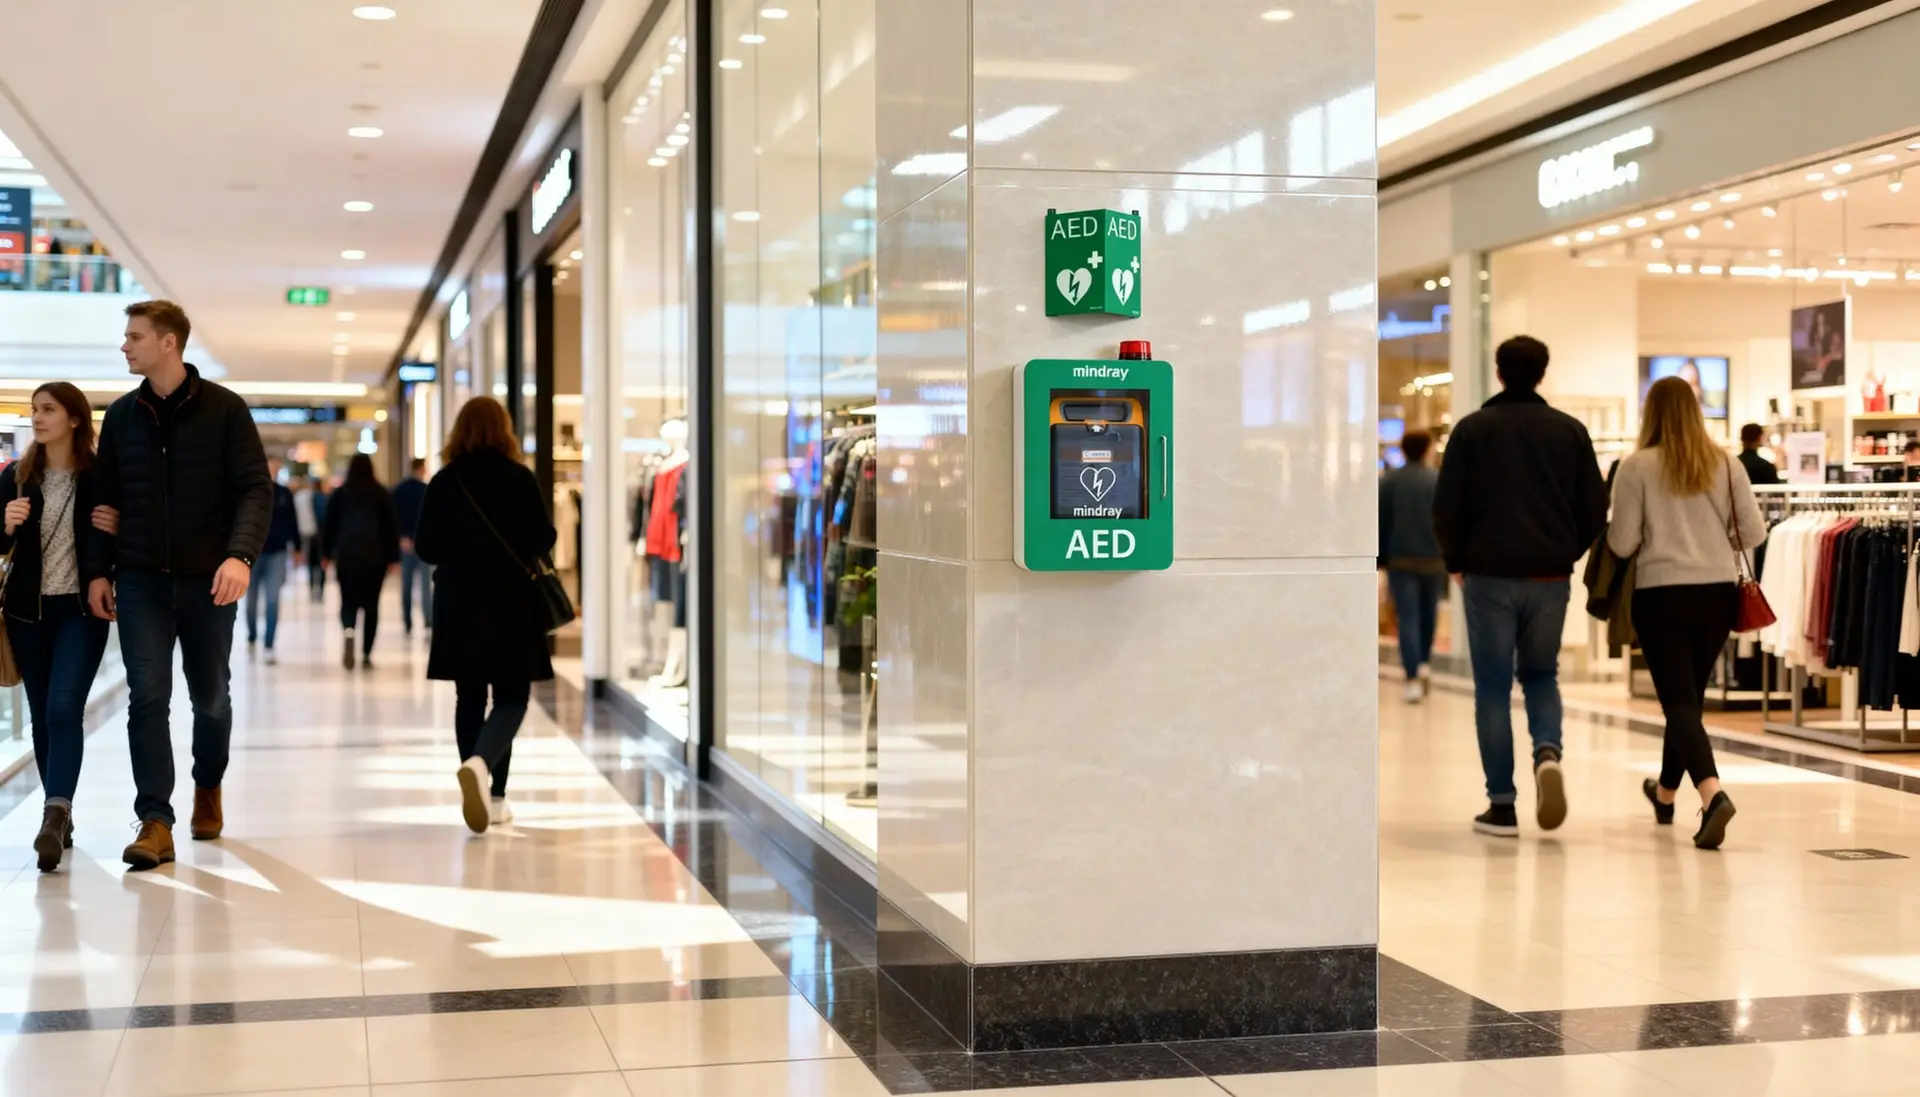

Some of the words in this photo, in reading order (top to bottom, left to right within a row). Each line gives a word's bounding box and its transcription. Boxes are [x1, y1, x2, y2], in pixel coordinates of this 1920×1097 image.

[1051, 216, 1098, 240] AED
[1107, 216, 1137, 240] AED
[1073, 365, 1129, 381] mindray
[1073, 505, 1123, 519] mindray
[1065, 529, 1136, 559] AED
